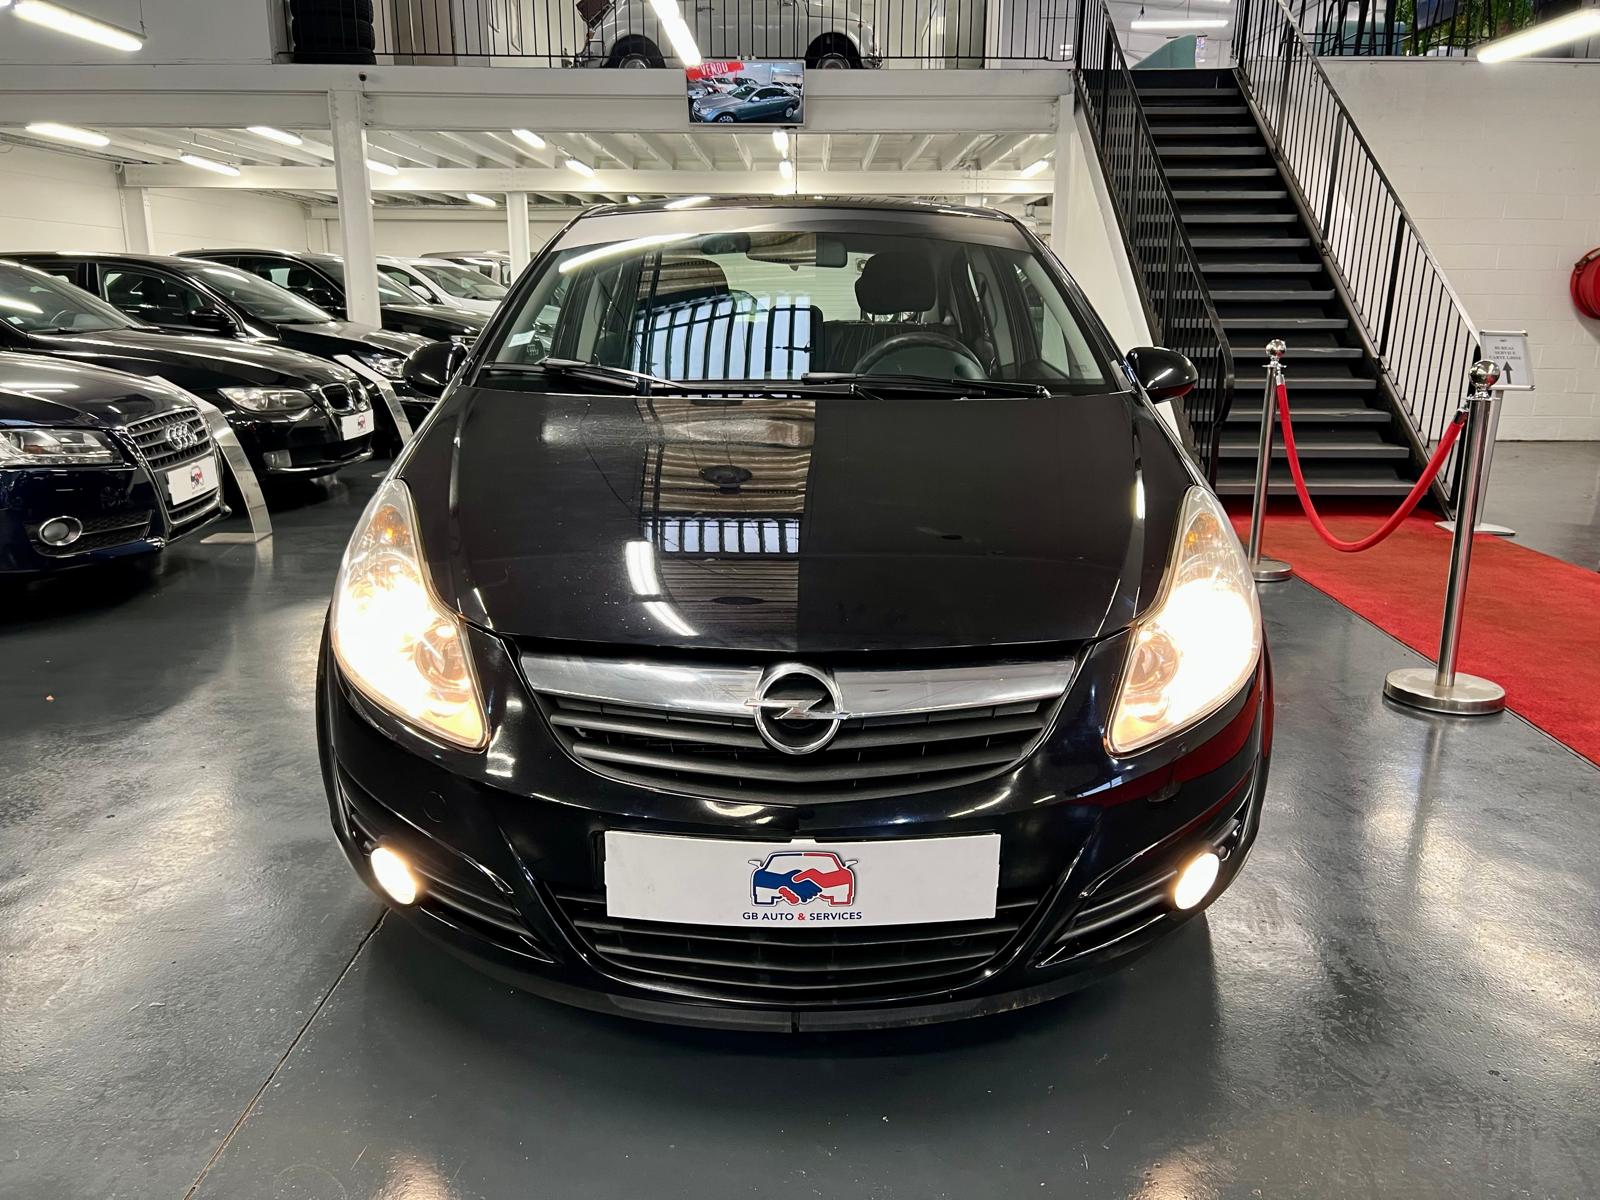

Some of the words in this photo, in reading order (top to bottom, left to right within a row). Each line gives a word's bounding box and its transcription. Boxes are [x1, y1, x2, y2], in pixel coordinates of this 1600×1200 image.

[700, 62, 728, 76] VENDU
[742, 912, 759, 920] GB
[761, 912, 794, 921] AUTO
[797, 912, 806, 921] &
[809, 911, 863, 921] SERVICES
